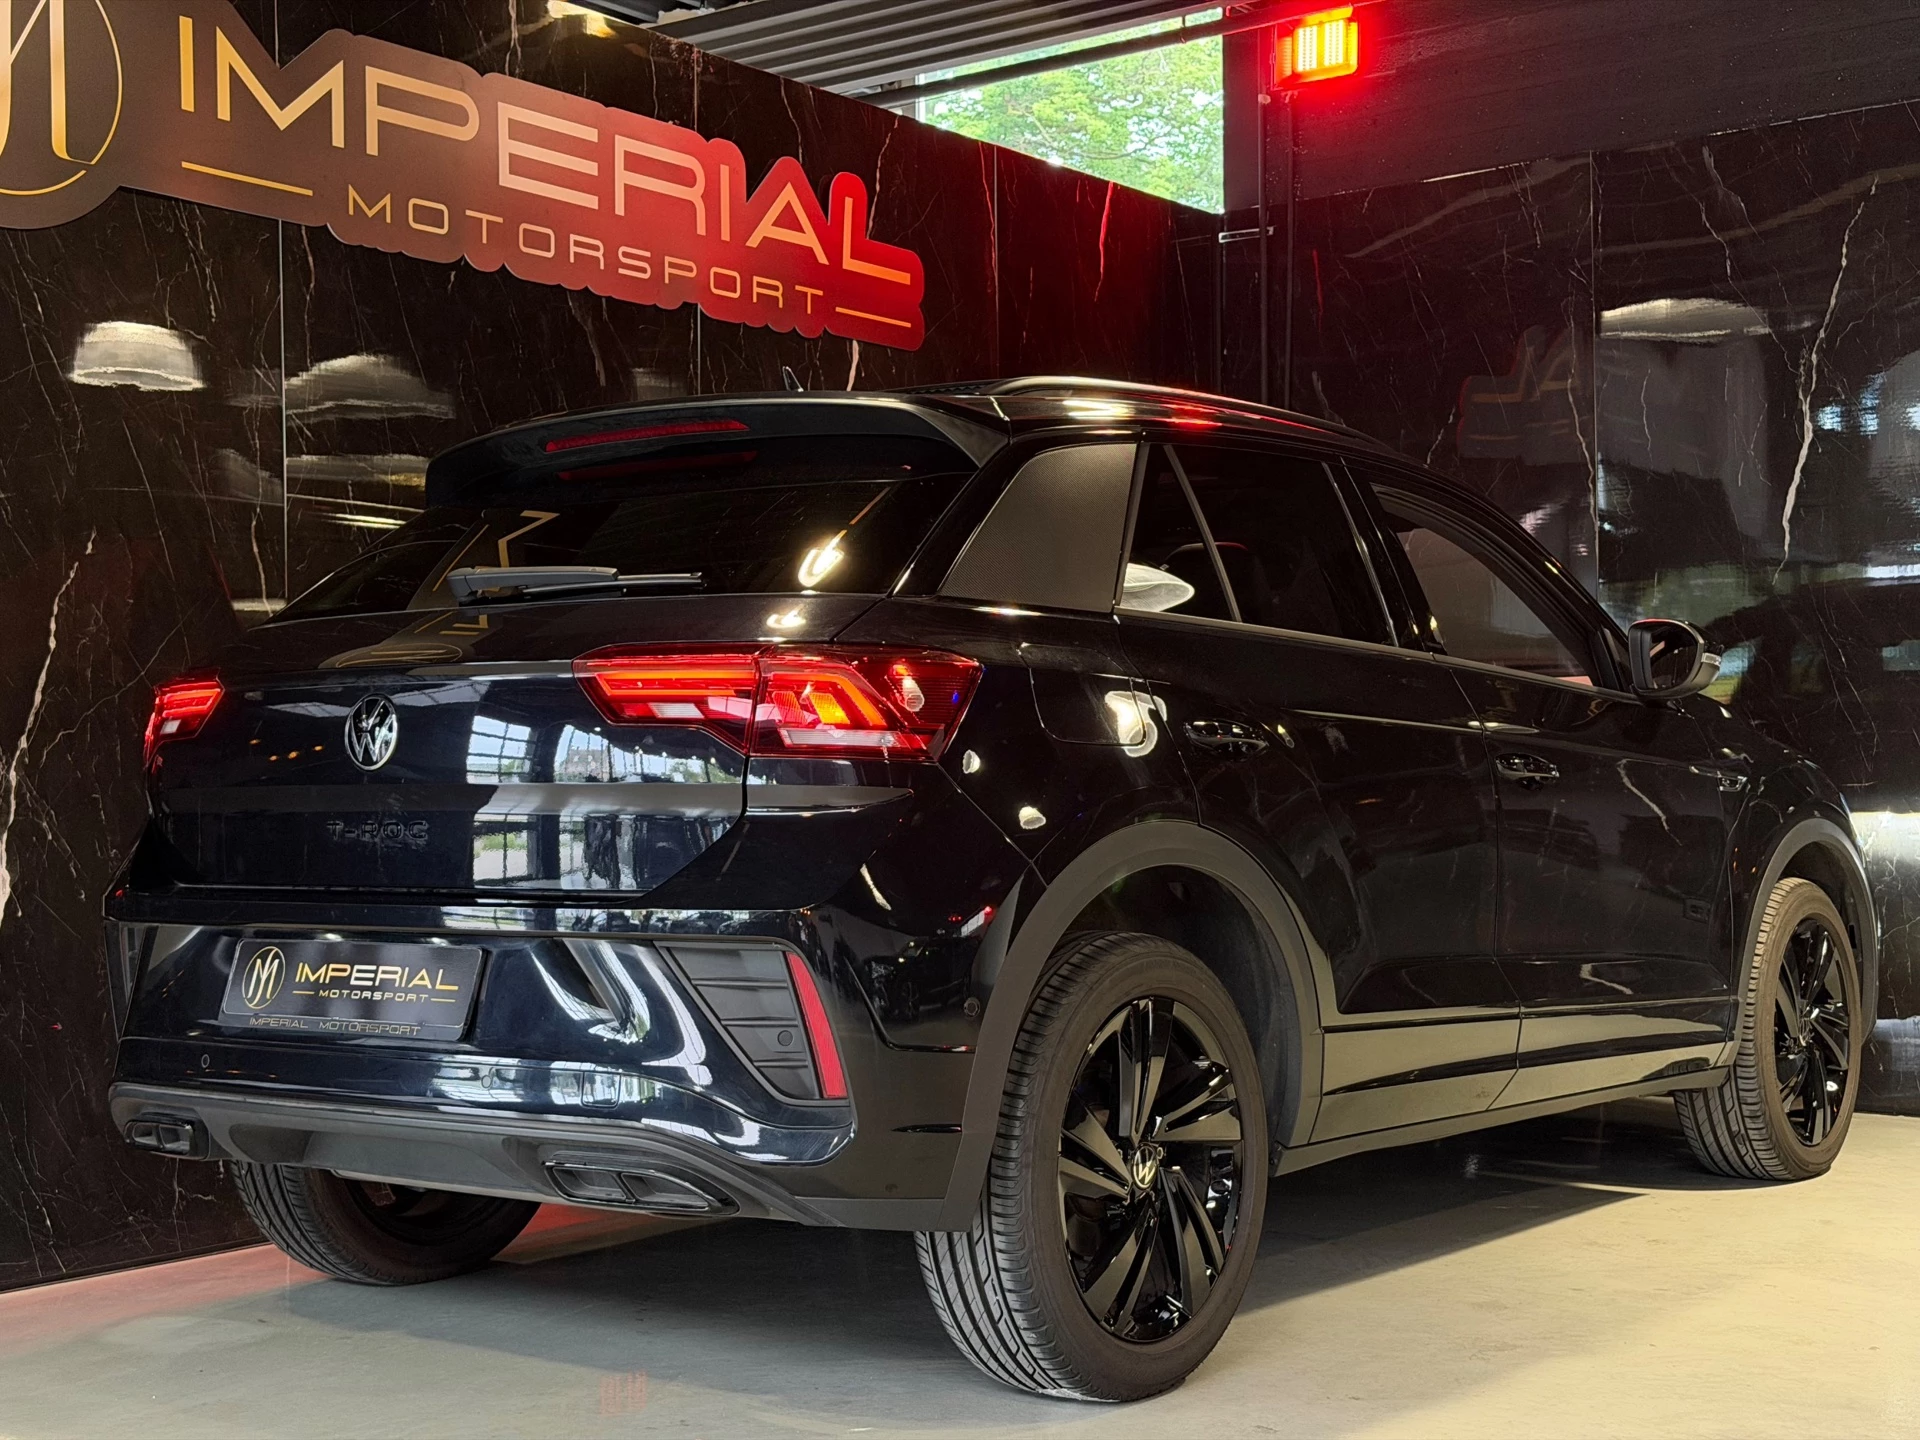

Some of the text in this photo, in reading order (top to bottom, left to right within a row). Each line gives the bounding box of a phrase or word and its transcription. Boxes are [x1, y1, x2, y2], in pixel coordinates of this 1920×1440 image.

[179, 15, 911, 285] IMPERIAL
[348, 185, 824, 315] MOTORSPORT
[326, 820, 429, 840] T-ROC
[295, 962, 459, 991] IMPERIAL
[318, 989, 428, 1003] MOTORSPORT
[250, 1017, 421, 1036] IMPERIAL MOTORSPORT
